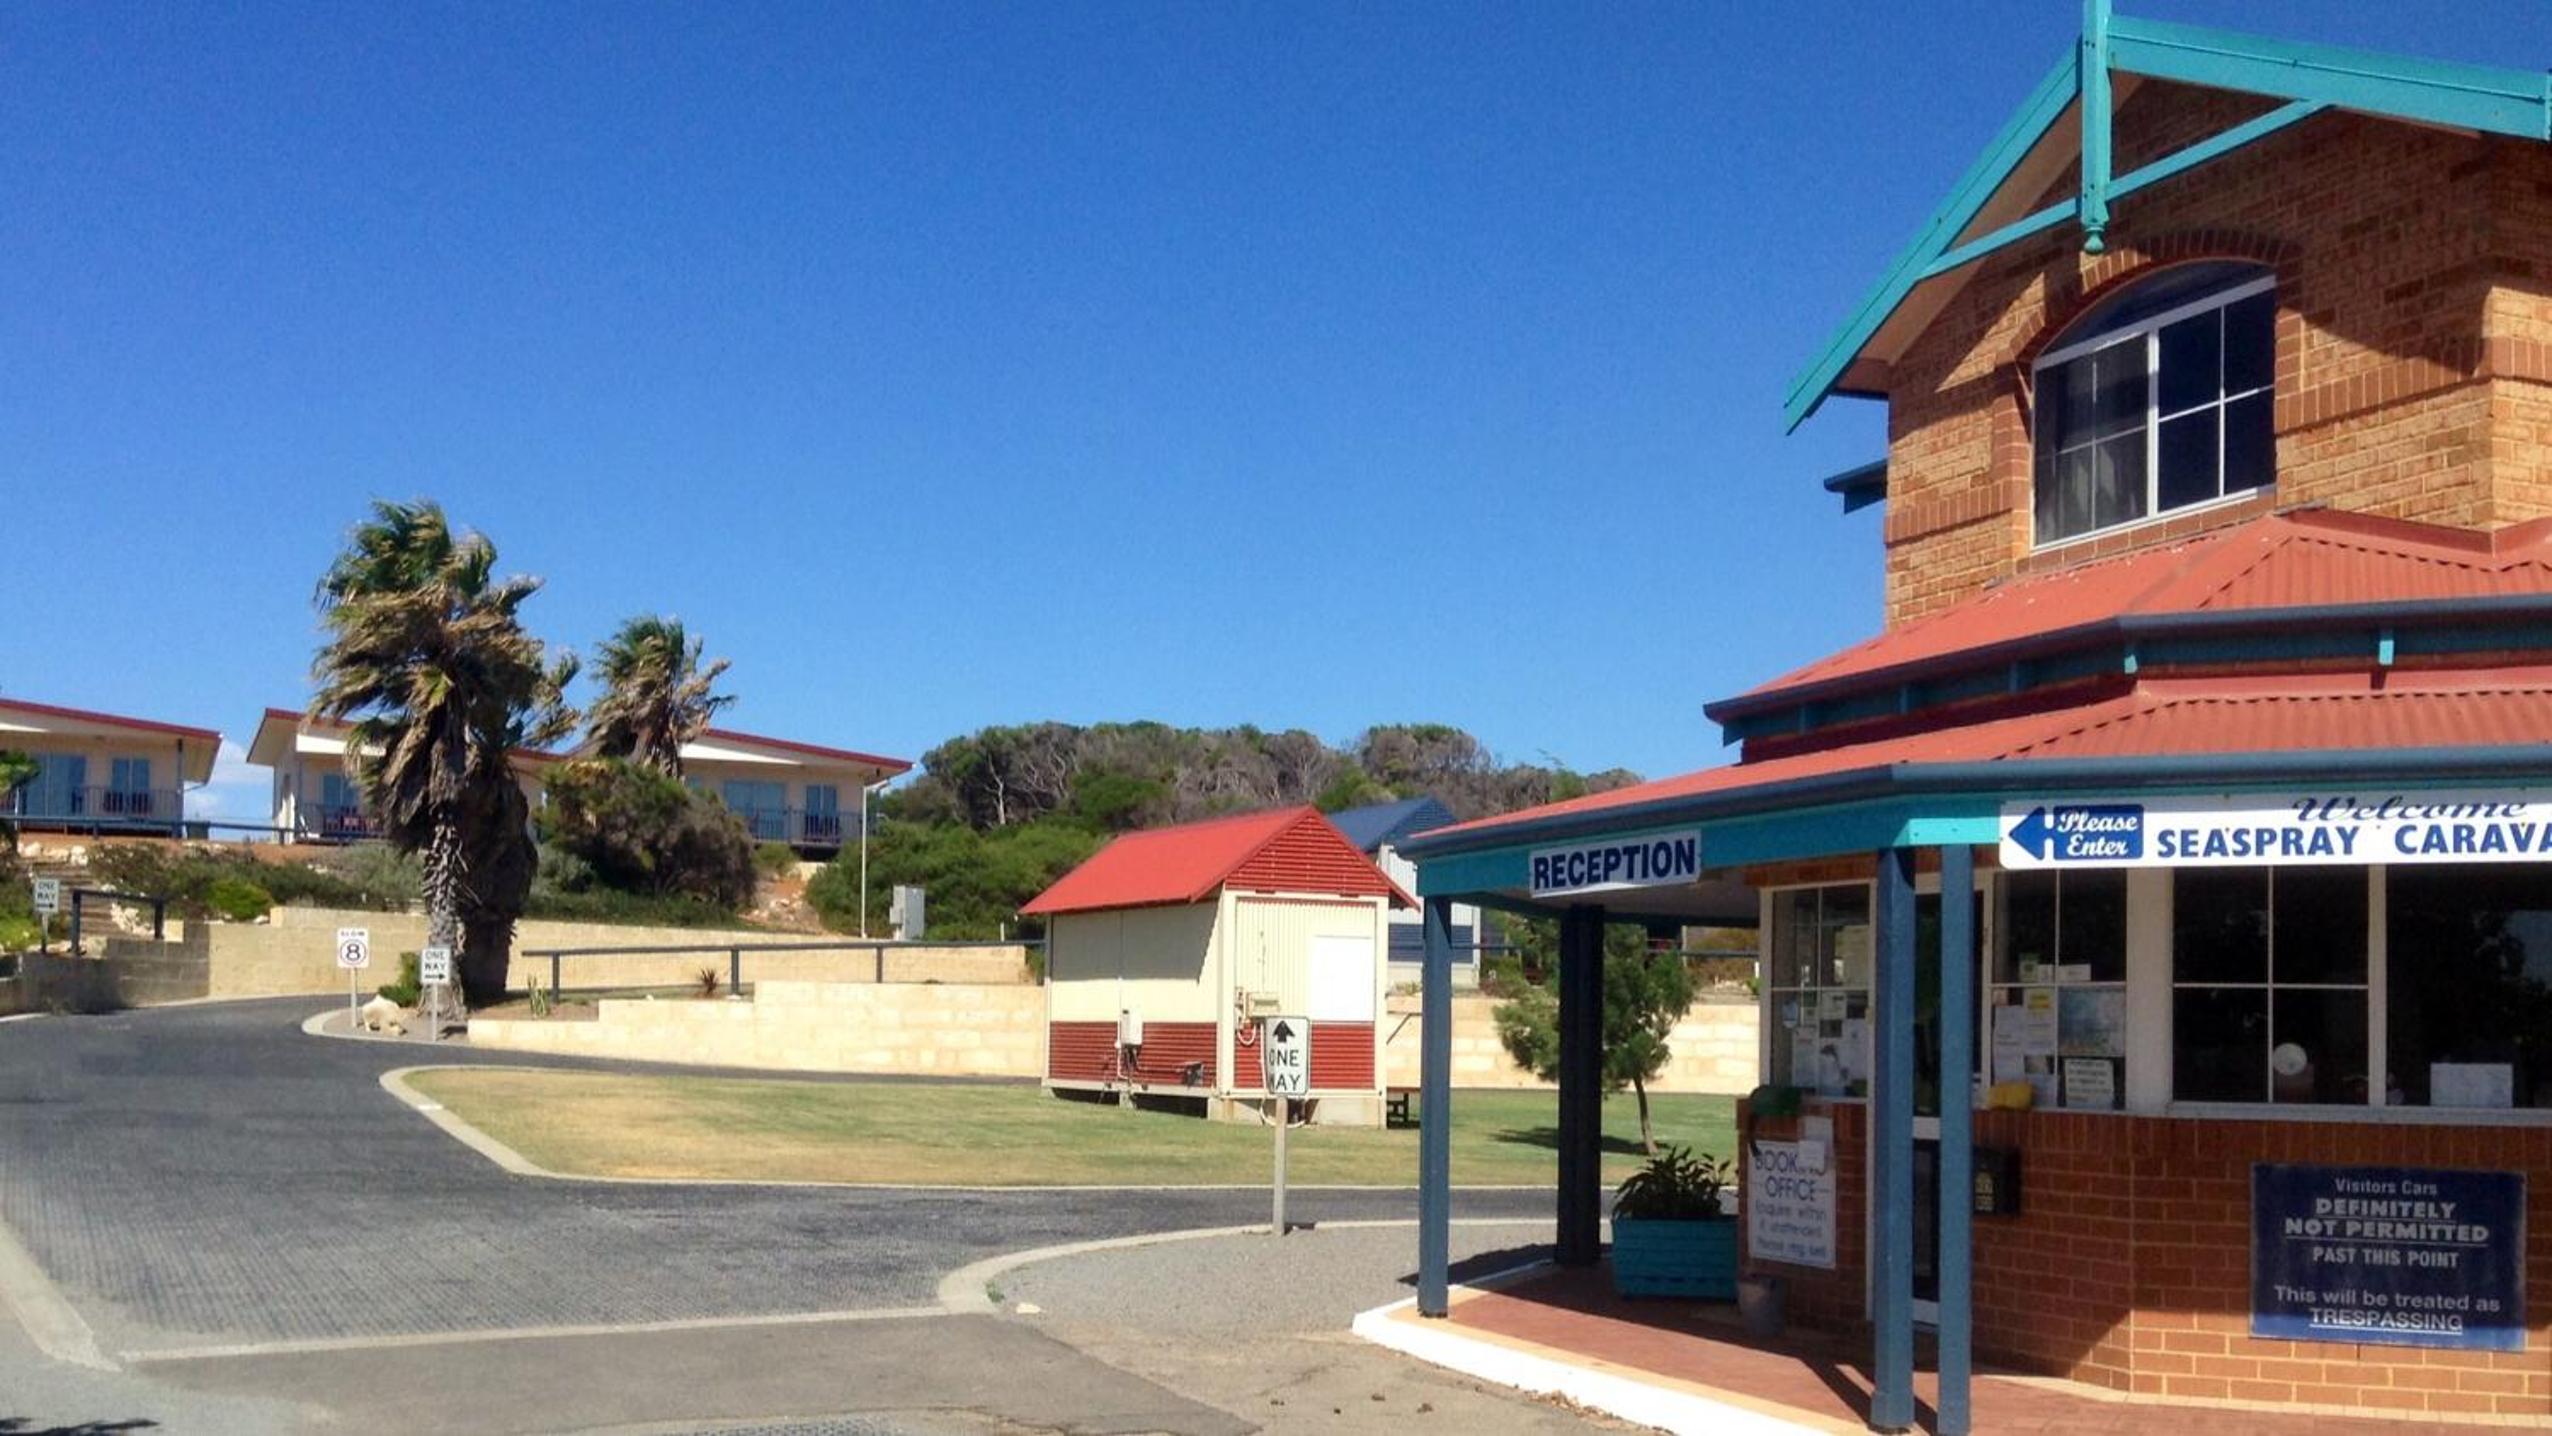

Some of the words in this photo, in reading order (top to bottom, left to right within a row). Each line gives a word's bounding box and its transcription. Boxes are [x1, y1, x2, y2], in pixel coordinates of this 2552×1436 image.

[2292, 795, 2527, 821] Welcome
[2057, 809, 2138, 833] Please
[2066, 833, 2129, 857] Enter
[2157, 825, 2360, 859] SEASPRAY
[1534, 838, 1696, 890] RECEPTION
[346, 943, 361, 962] 8
[425, 950, 446, 961] ONE
[424, 962, 446, 972] WAY
[1268, 1048, 1300, 1067] ONE
[1755, 1149, 1827, 1176] BOOK
[1765, 1175, 1817, 1202] OFFICE
[2334, 1178, 2396, 1194] Visitors
[2401, 1180, 2438, 1196] Cars
[2315, 1198, 2457, 1220] DEFINITELY
[2285, 1218, 2342, 1236] NOT
[2346, 1220, 2489, 1242] PERMITTED
[2312, 1247, 2356, 1264] PAST
[2363, 1249, 2401, 1267] THIS
[2407, 1250, 2460, 1269] POINT
[2273, 1285, 2317, 1304] This
[2322, 1288, 2356, 1305] will
[2362, 1290, 2389, 1307] be
[2395, 1292, 2470, 1311] treated
[2475, 1298, 2501, 1312] as
[2309, 1307, 2464, 1331] TRESPASSING
